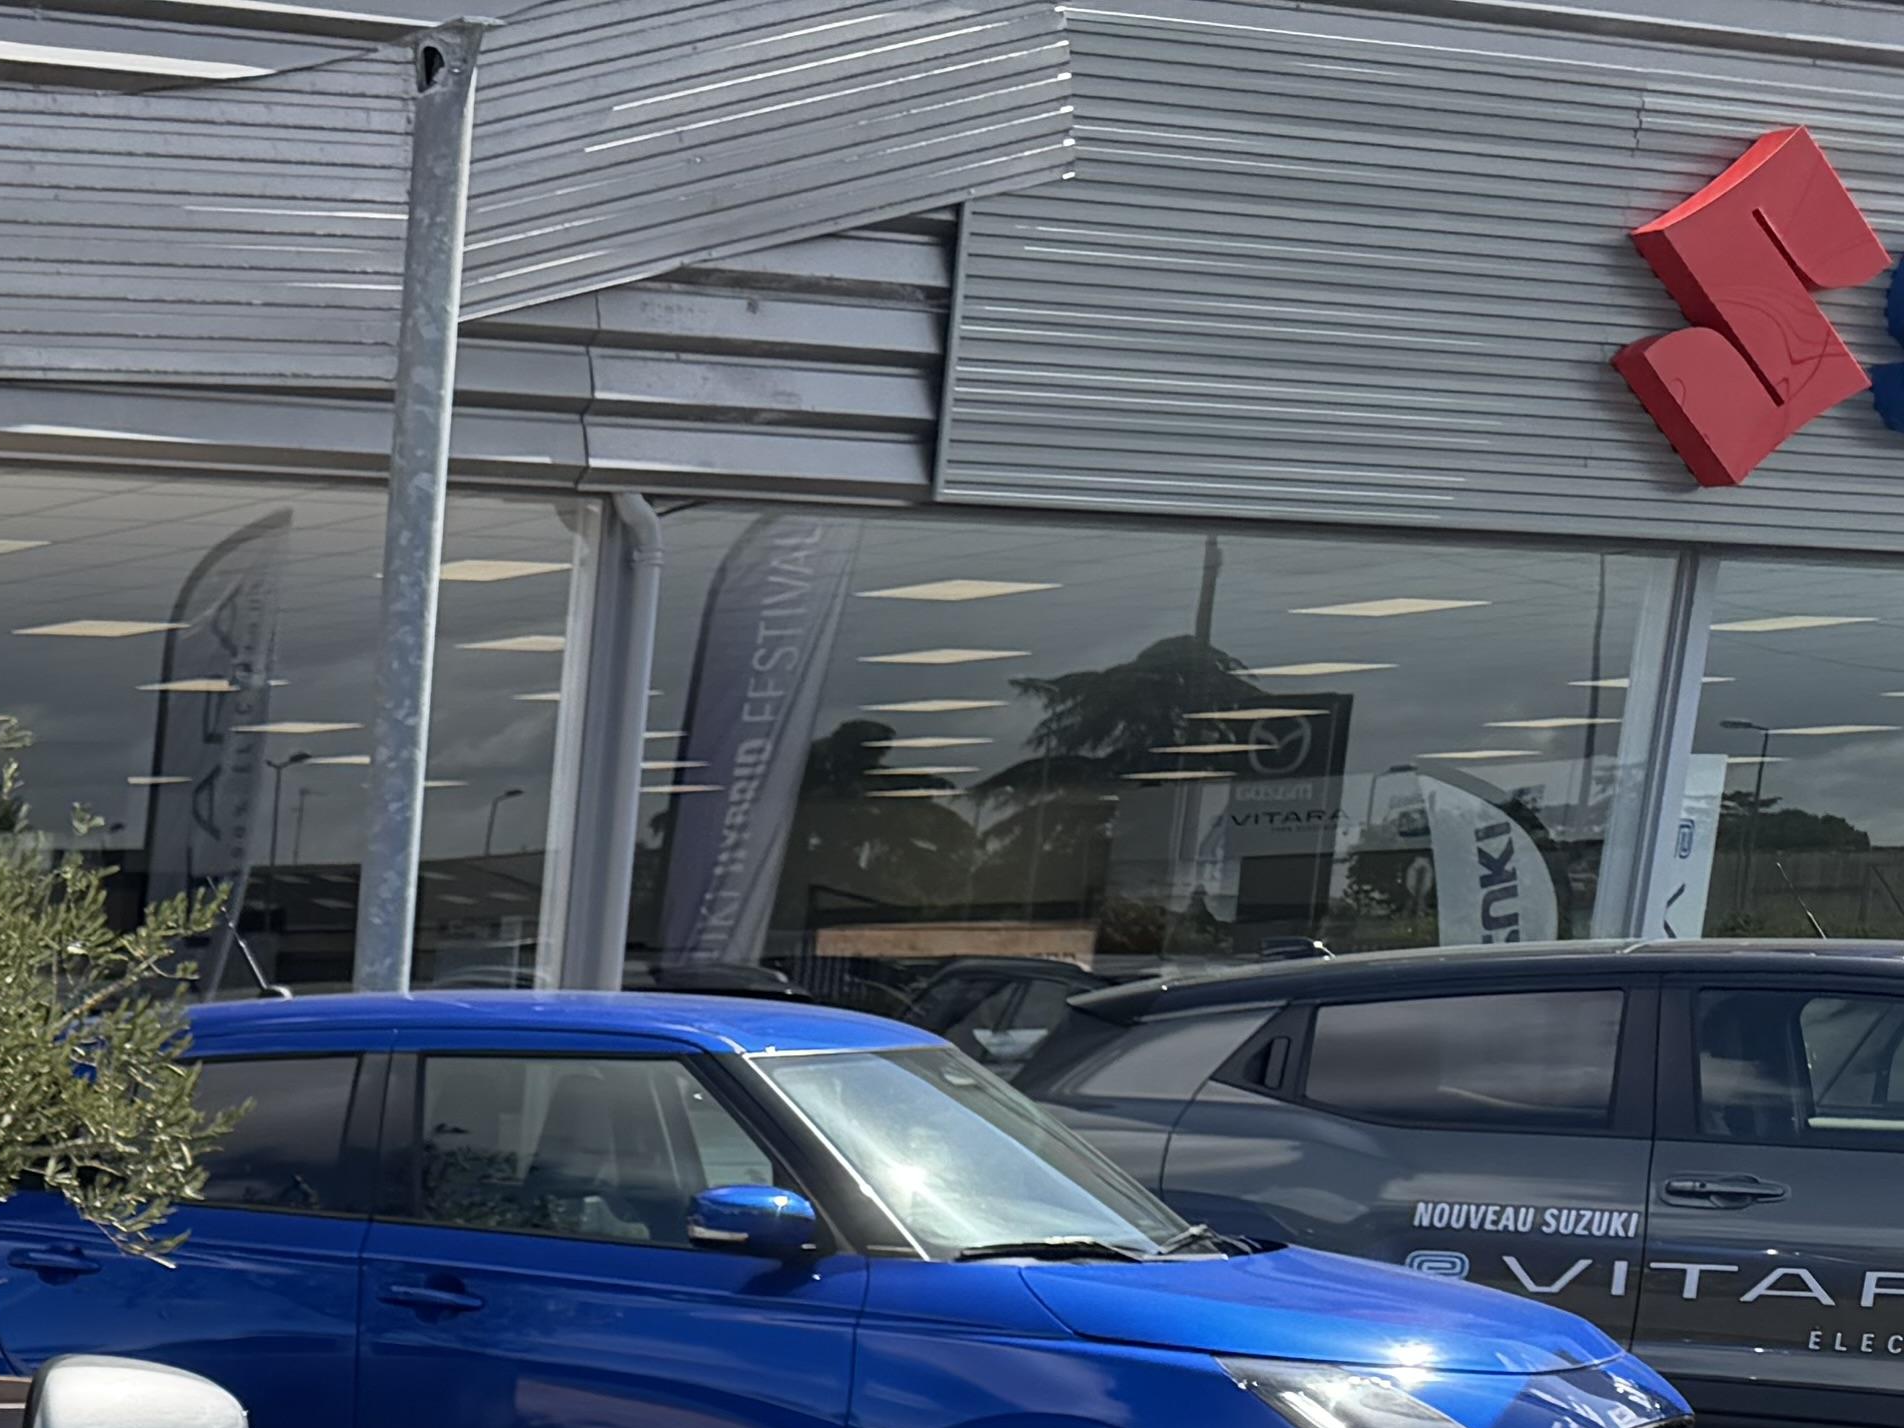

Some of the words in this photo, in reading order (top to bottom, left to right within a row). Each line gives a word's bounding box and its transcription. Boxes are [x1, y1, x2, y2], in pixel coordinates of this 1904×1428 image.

[1231, 808, 1349, 827] VITARA
[1412, 1201, 1536, 1233] NOUVEAU
[1541, 1207, 1640, 1238] SUZUKI
